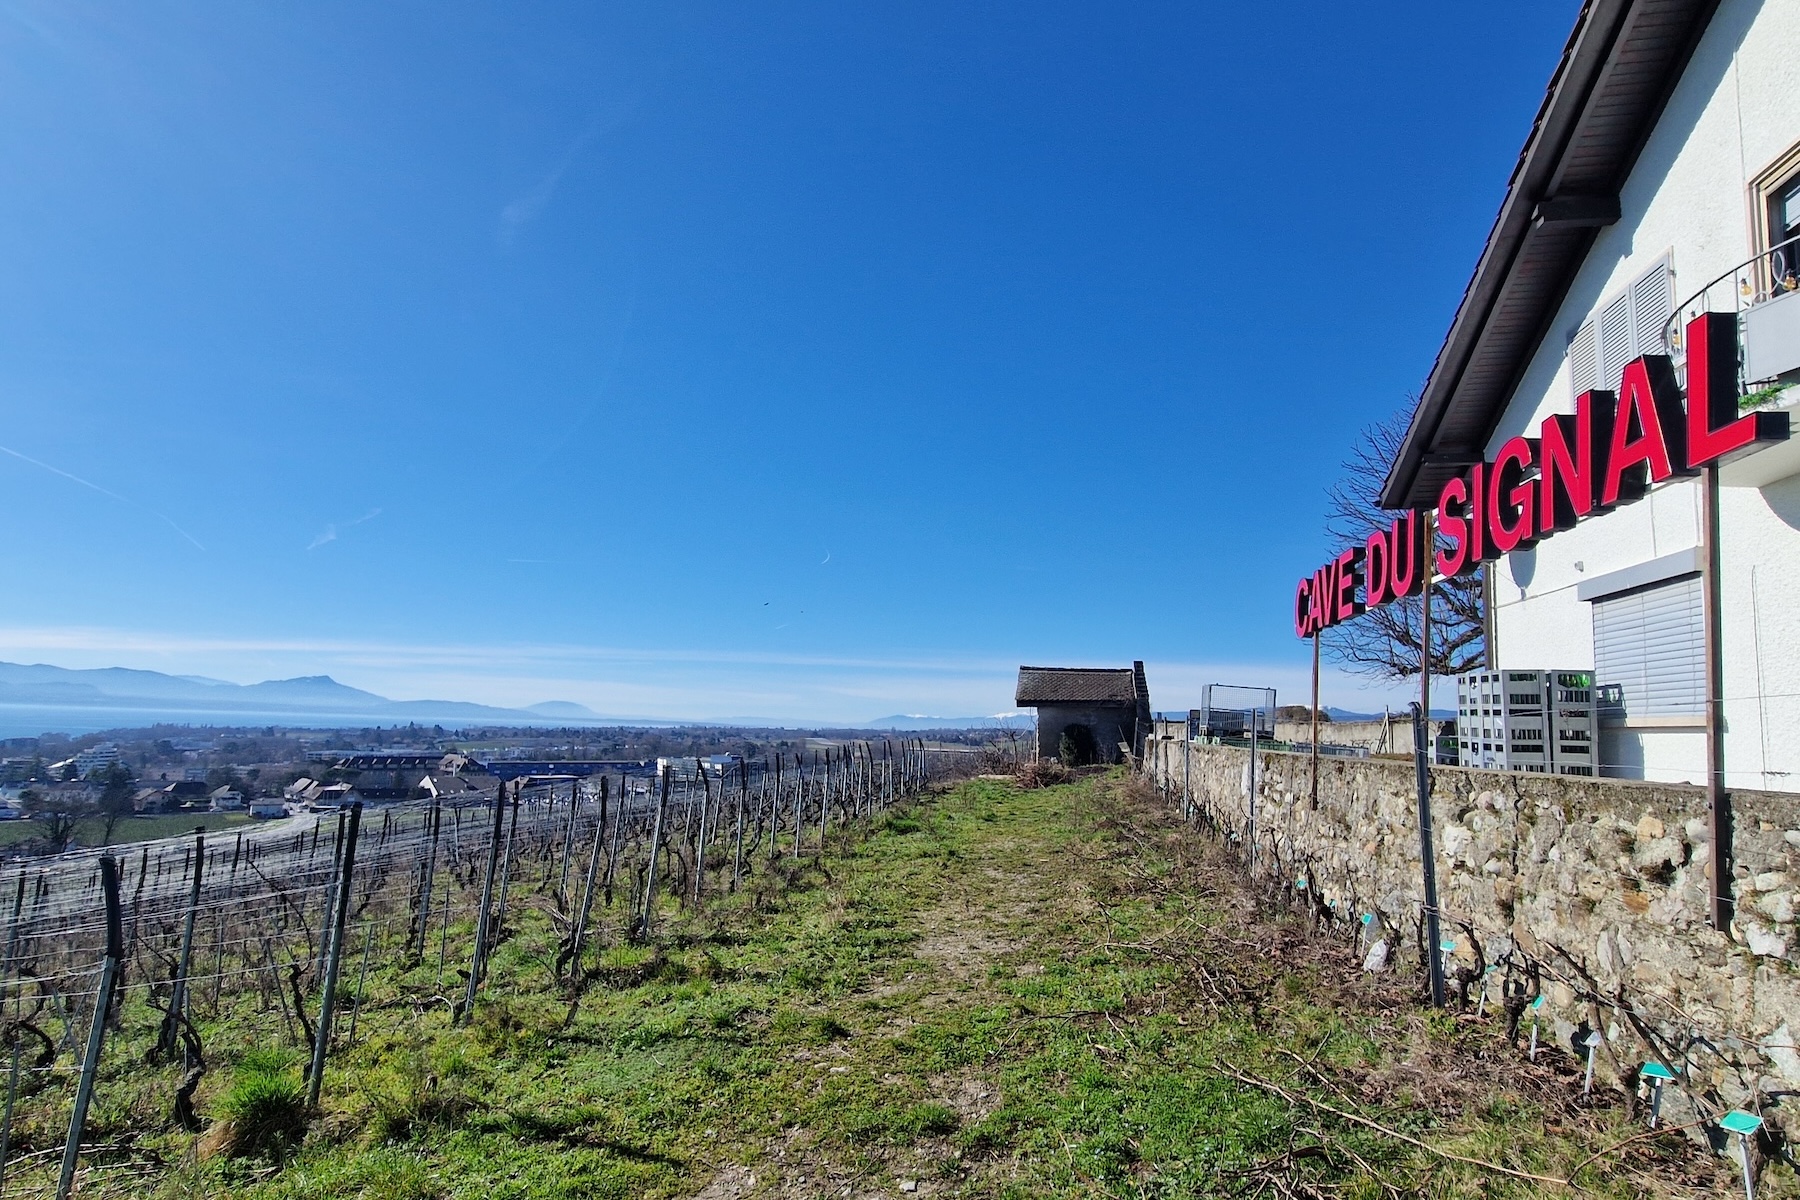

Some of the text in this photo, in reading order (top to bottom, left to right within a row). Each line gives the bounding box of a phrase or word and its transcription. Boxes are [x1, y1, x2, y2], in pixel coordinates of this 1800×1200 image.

[1294, 312, 1758, 639] CAVE DU SIGNAL
